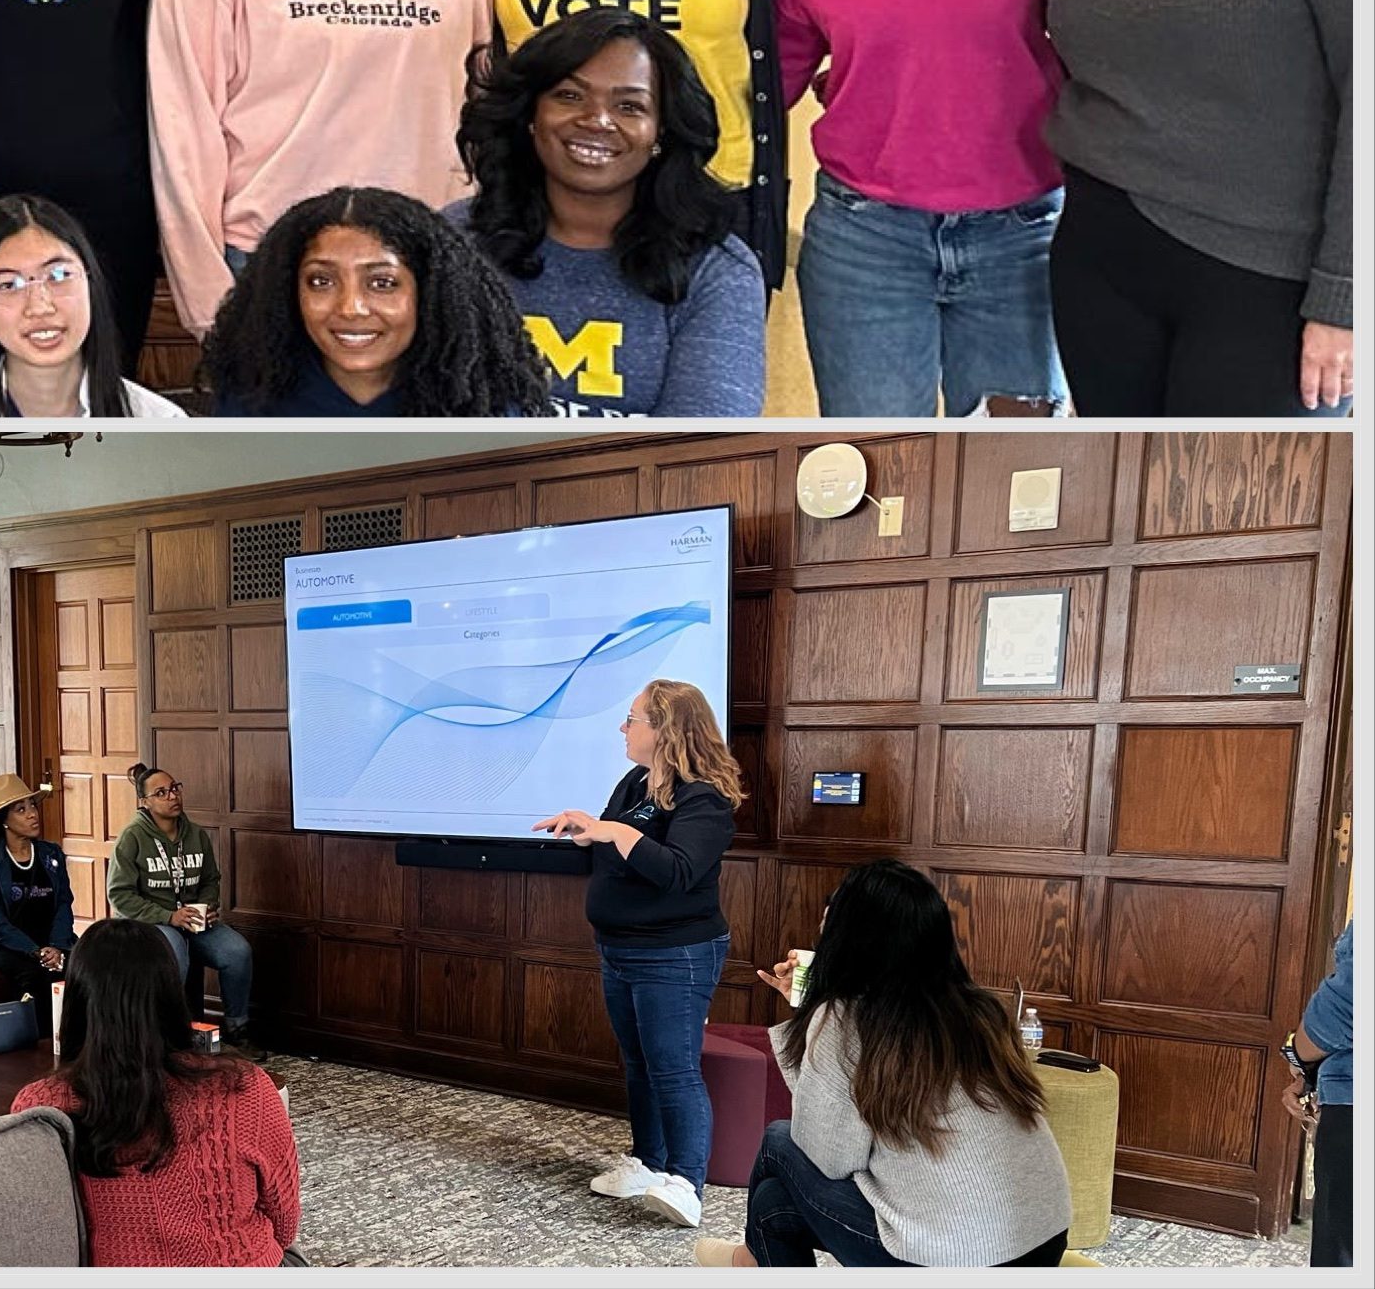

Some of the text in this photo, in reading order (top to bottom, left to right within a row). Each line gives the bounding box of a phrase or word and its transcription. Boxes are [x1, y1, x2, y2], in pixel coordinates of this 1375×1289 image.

[288, 0, 442, 26] Breckenridge
[326, 15, 413, 28] Colorado
[522, 316, 623, 397] M
[670, 535, 713, 547] HARMAN
[295, 573, 355, 589] AUTOMOTIVE
[332, 611, 374, 622] AUTOMOTIVE
[463, 629, 500, 640] Categories
[1243, 675, 1291, 683] OCCUPANCY
